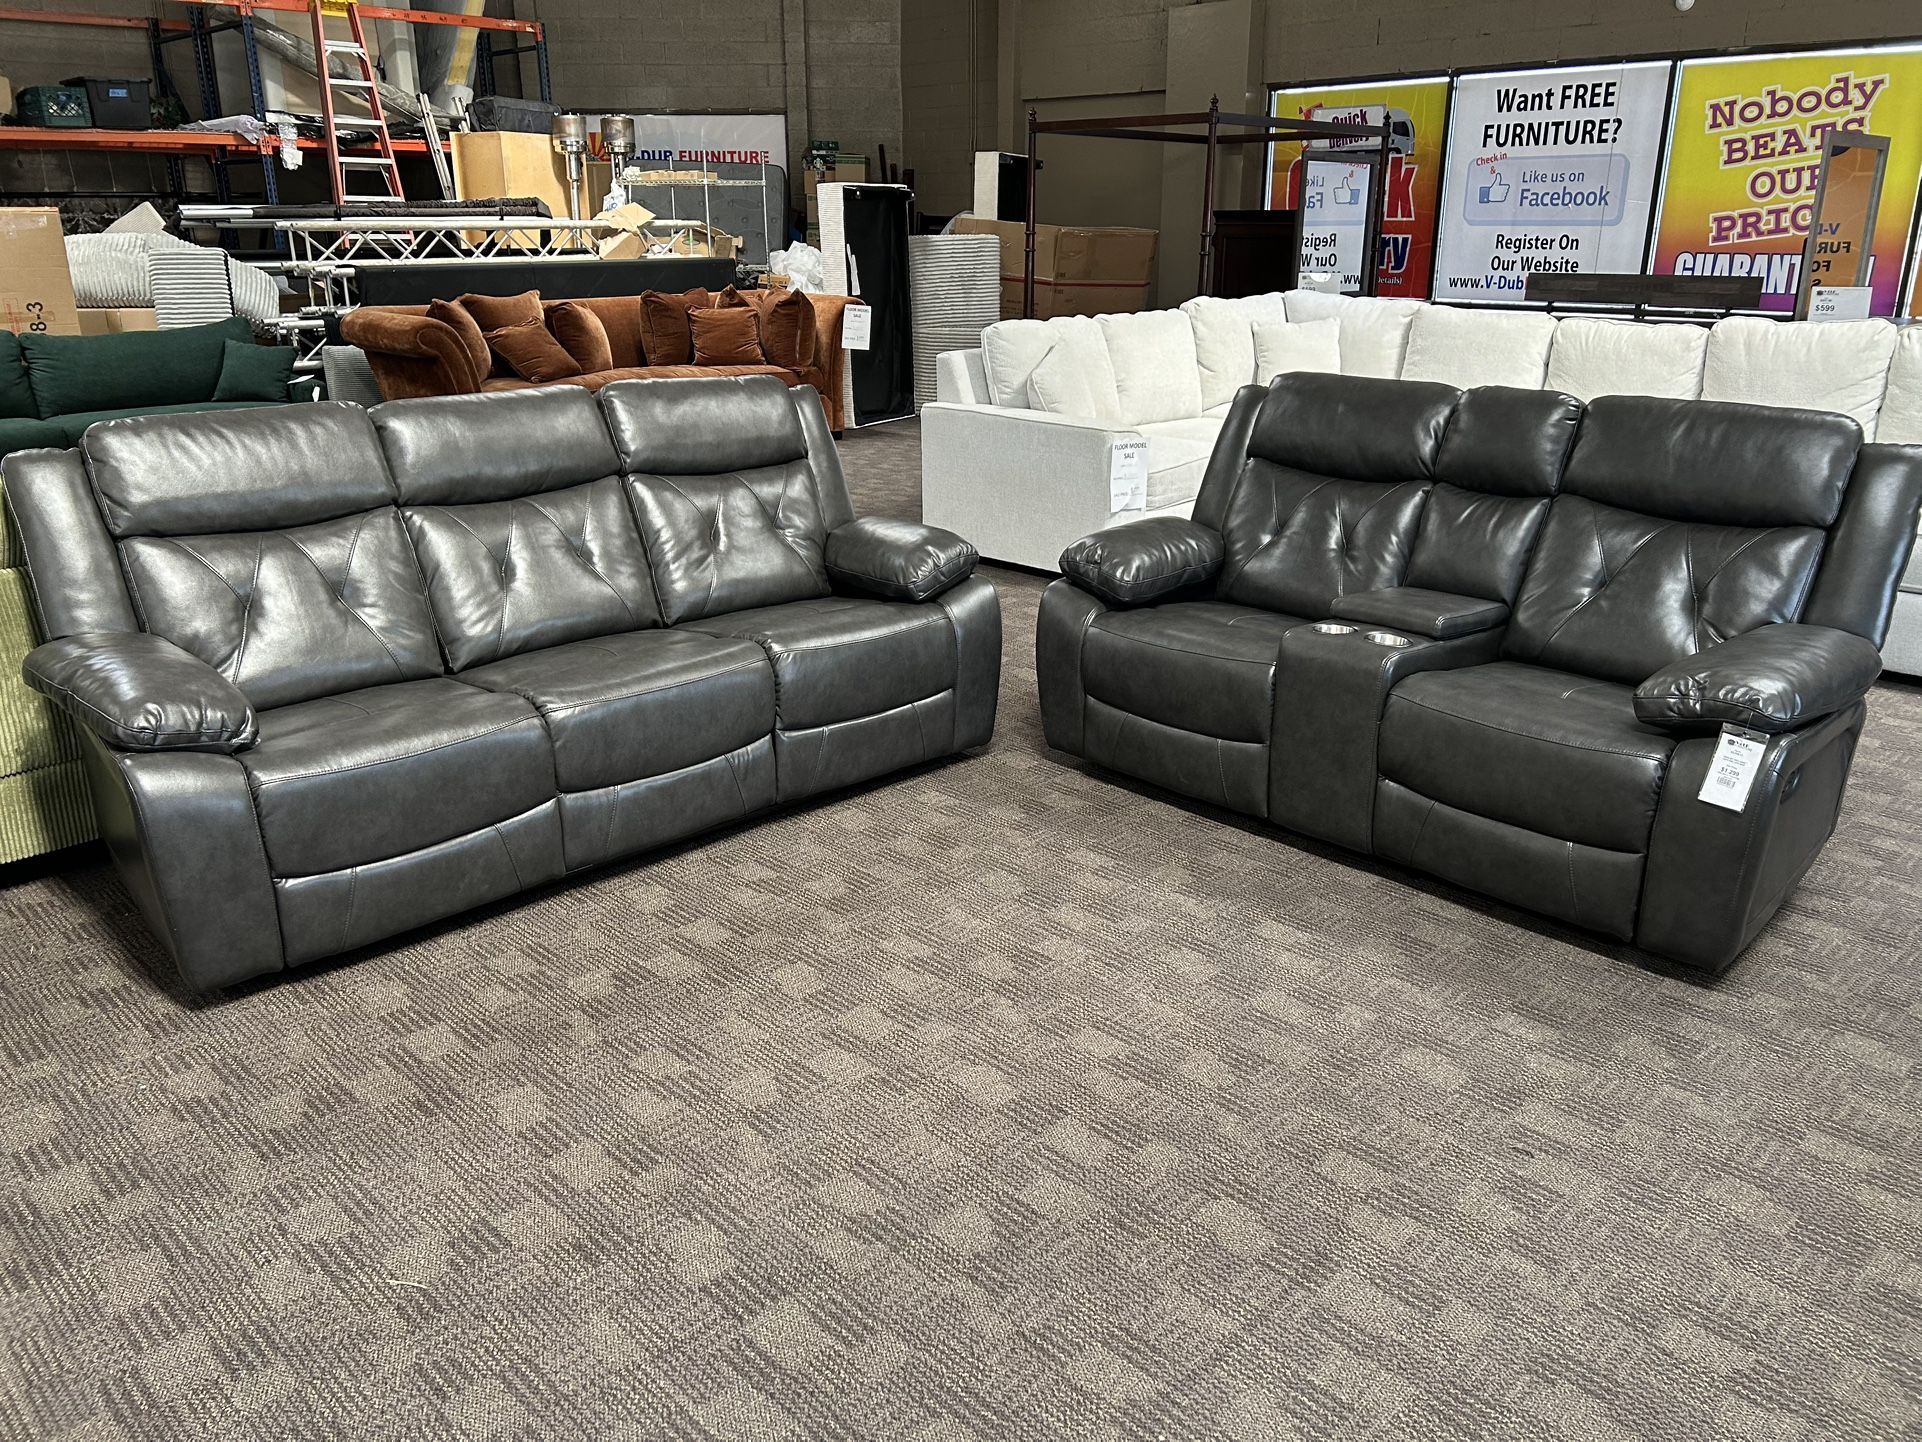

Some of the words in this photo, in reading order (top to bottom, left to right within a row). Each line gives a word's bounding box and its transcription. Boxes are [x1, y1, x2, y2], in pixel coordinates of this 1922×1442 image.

[1496, 87, 1554, 113] Want
[1559, 82, 1617, 110] FREE
[1707, 74, 1887, 131] Nobody
[1482, 118, 1623, 148] FURNITURE?
[1475, 153, 1498, 166] Check
[1499, 151, 1507, 160] in
[1490, 165, 1496, 174] &
[1522, 170, 1547, 183] Like
[1551, 173, 1565, 182] us
[1568, 171, 1585, 182] on
[1519, 186, 1610, 207] Facebook
[1710, 203, 1812, 244] PRIC
[1495, 234, 1556, 253] Register
[1558, 234, 1579, 250] On
[1490, 255, 1517, 272] Our
[1520, 256, 1579, 273] Website
[1449, 274, 1525, 290] www.V-Dub
[1815, 304, 1835, 312] $599
